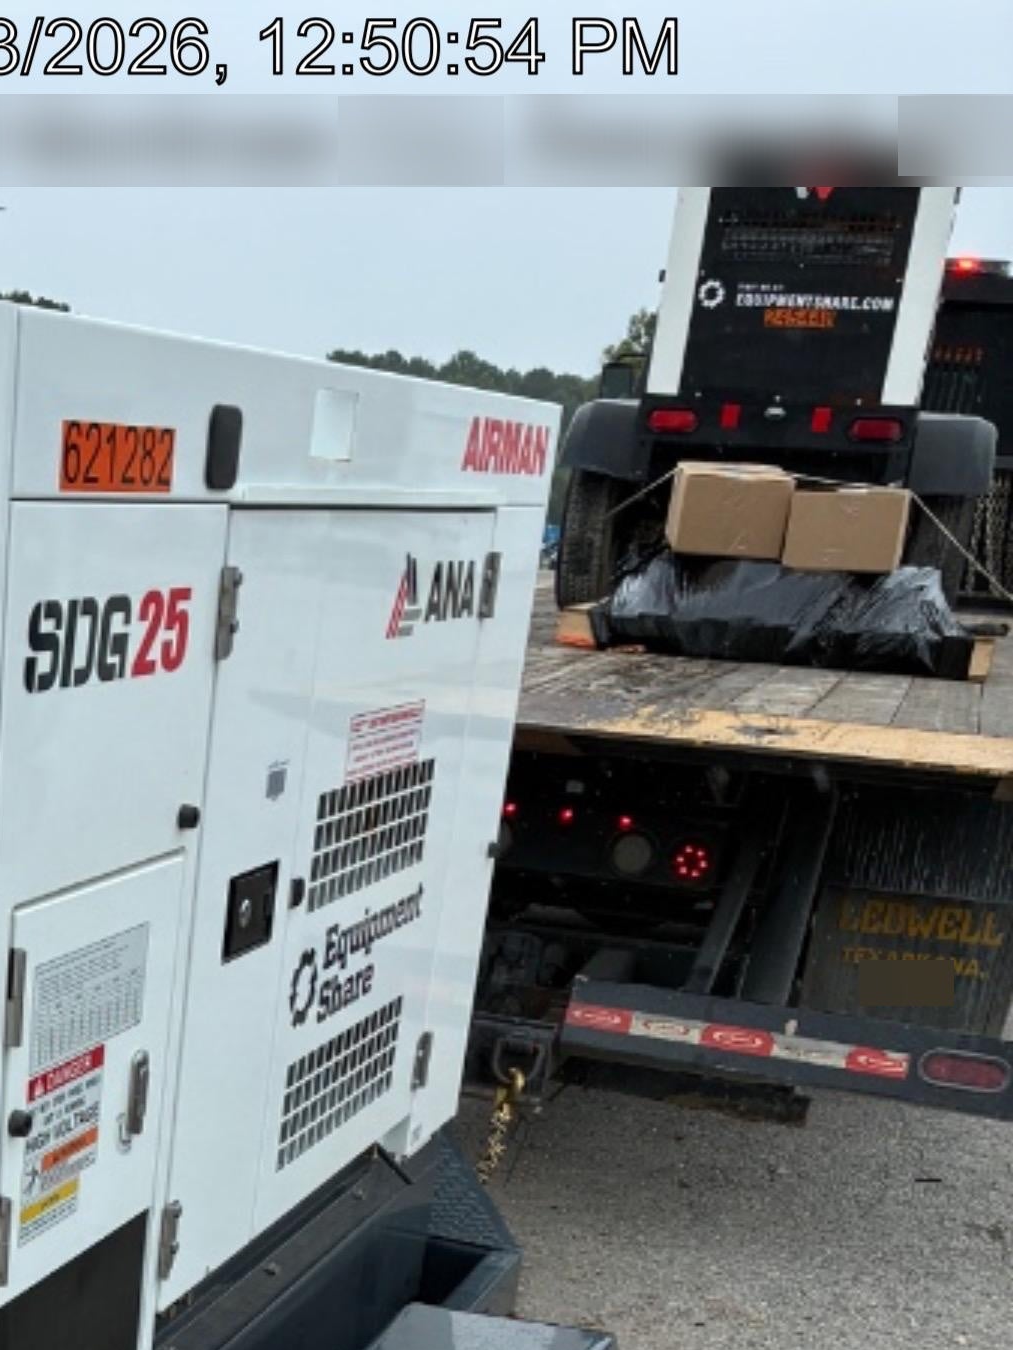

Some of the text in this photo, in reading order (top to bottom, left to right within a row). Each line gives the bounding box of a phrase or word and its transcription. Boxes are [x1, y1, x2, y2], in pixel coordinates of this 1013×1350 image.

[64, 420, 174, 486] 621282
[462, 414, 550, 477] AIRMAN
[424, 560, 475, 623] ANA
[24, 587, 192, 694] SDG25
[322, 882, 424, 970] Equipment
[840, 898, 1004, 947] LEDWELL
[316, 963, 375, 1024] Share
